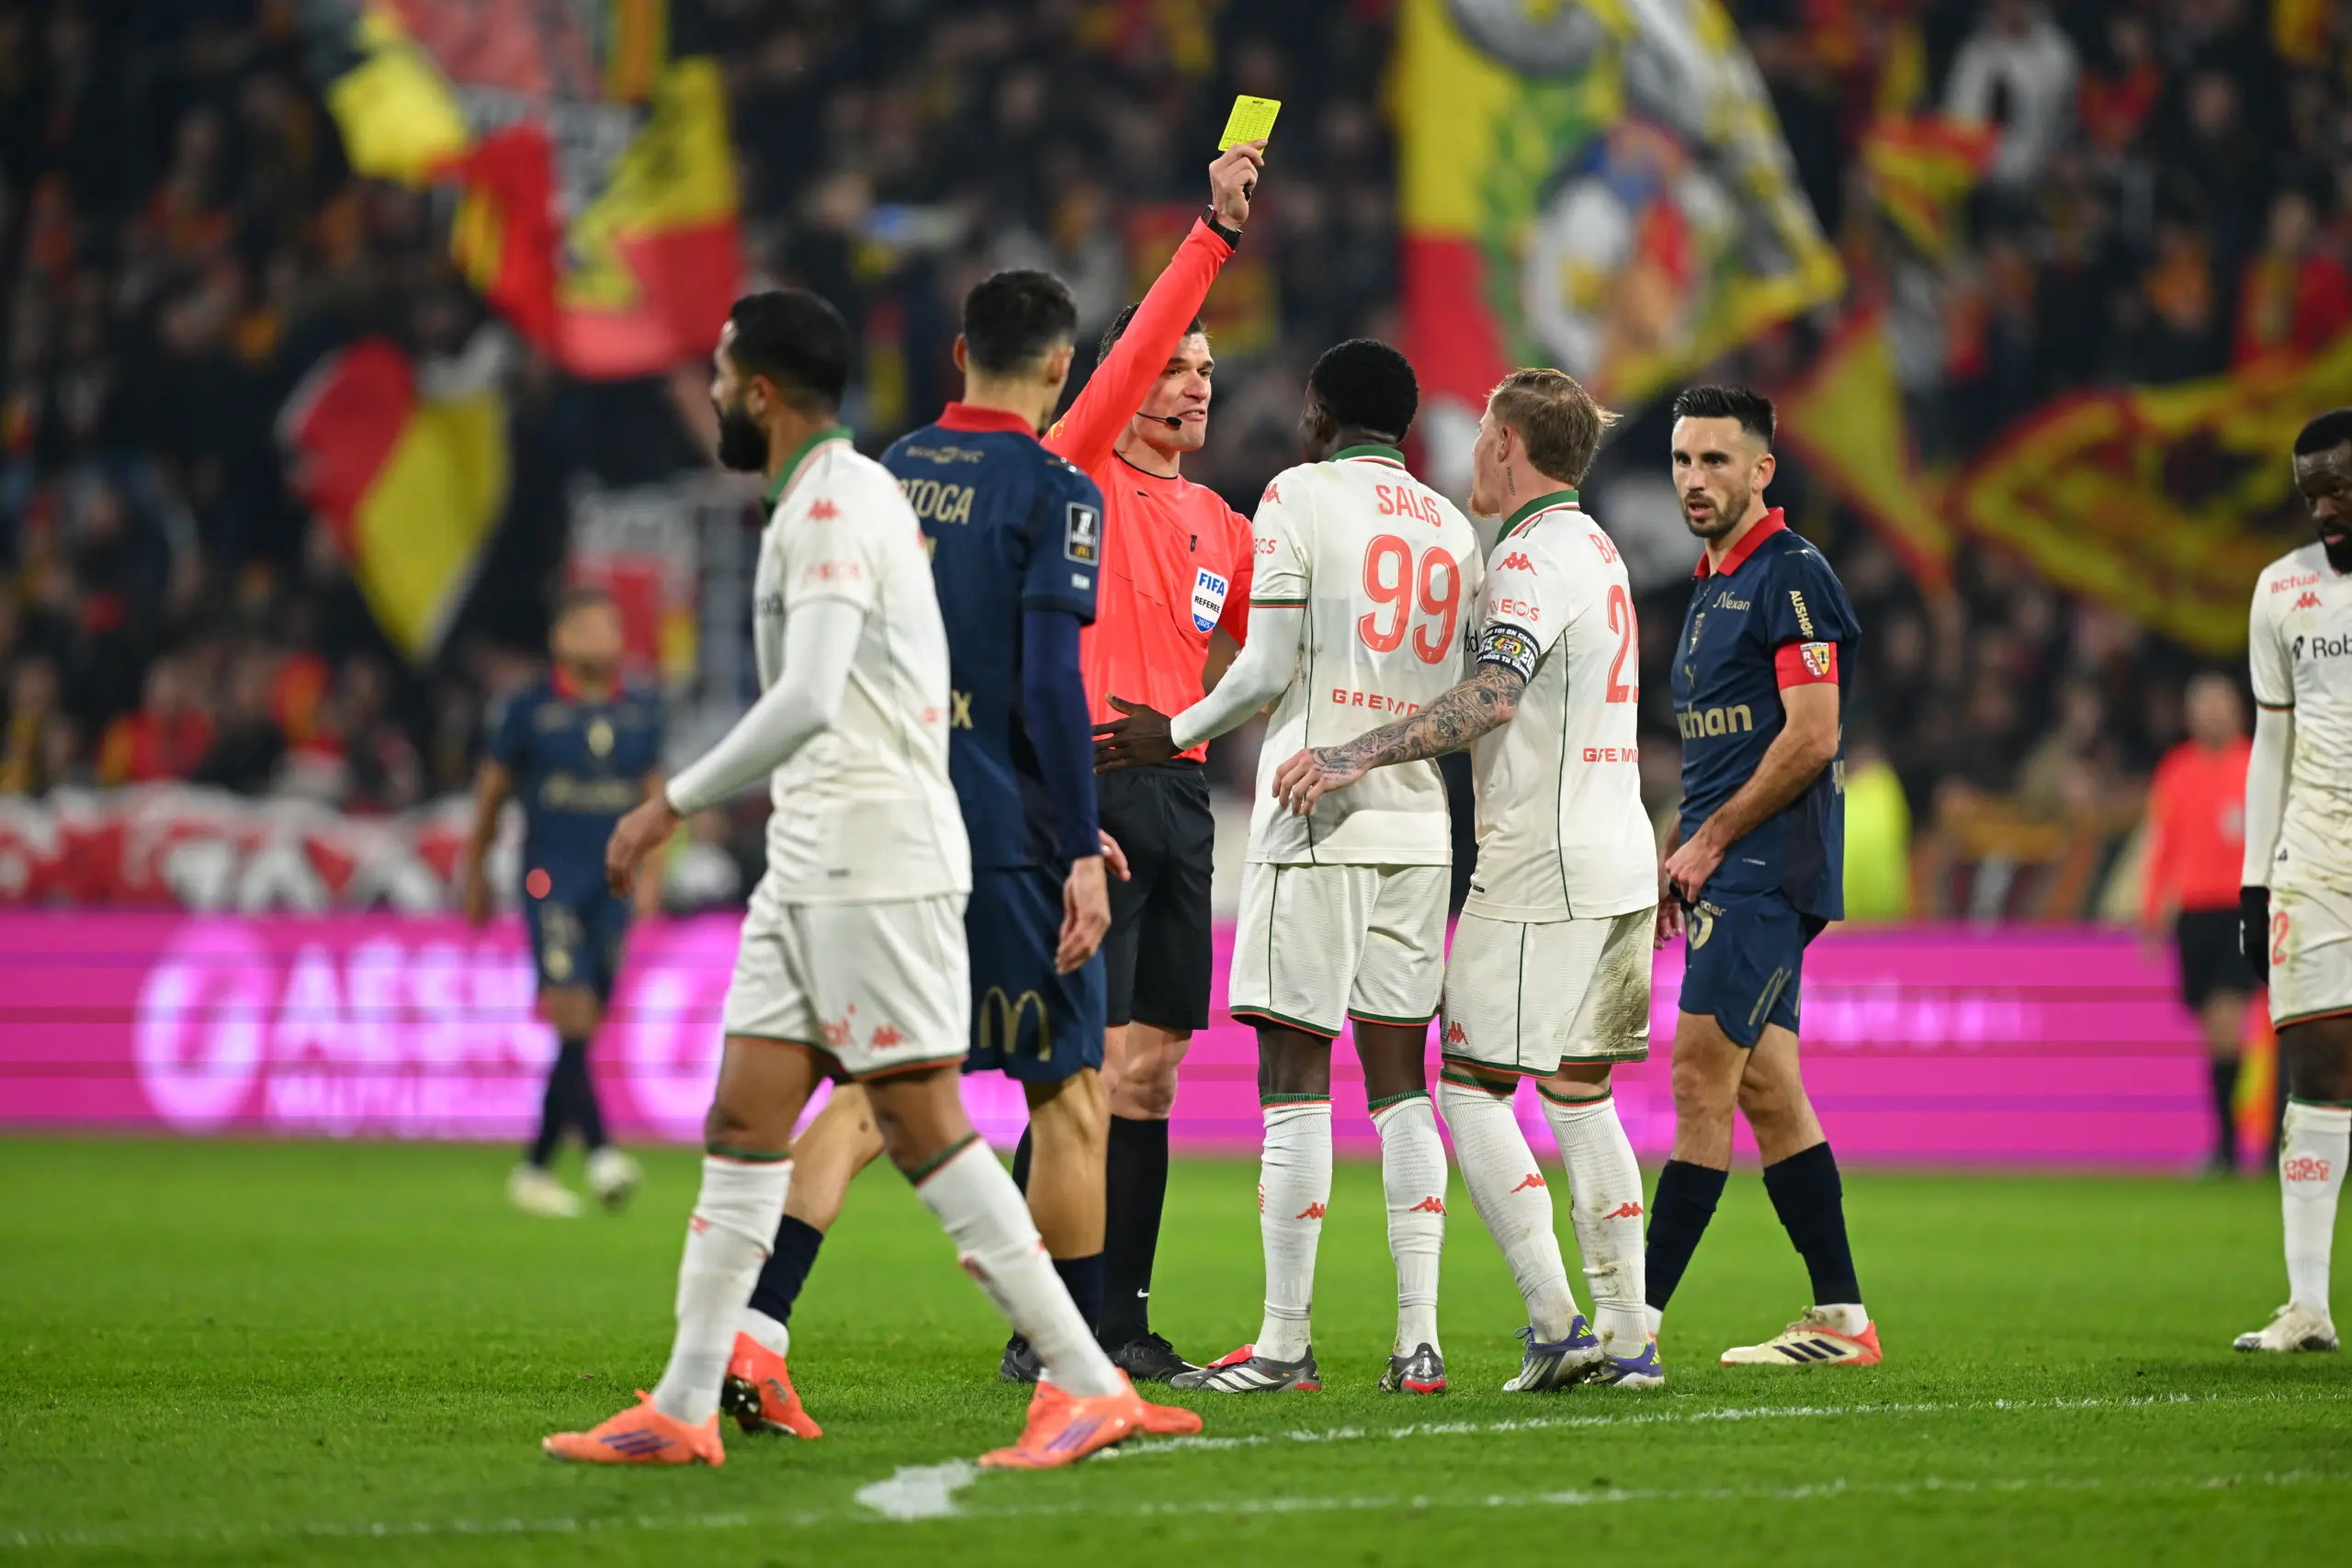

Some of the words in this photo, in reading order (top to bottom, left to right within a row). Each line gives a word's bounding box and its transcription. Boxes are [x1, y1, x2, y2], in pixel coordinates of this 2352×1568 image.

[1375, 484, 1442, 527] SALIS
[1198, 572, 1226, 597] FIFA
[1358, 534, 1461, 665] 99
[1194, 595, 1220, 614] REFEREE
[1789, 591, 1815, 639] AUSHOP
[1197, 617, 1211, 629] 2025
[1605, 584, 1640, 705] 2
[1803, 650, 1821, 676] RCL
